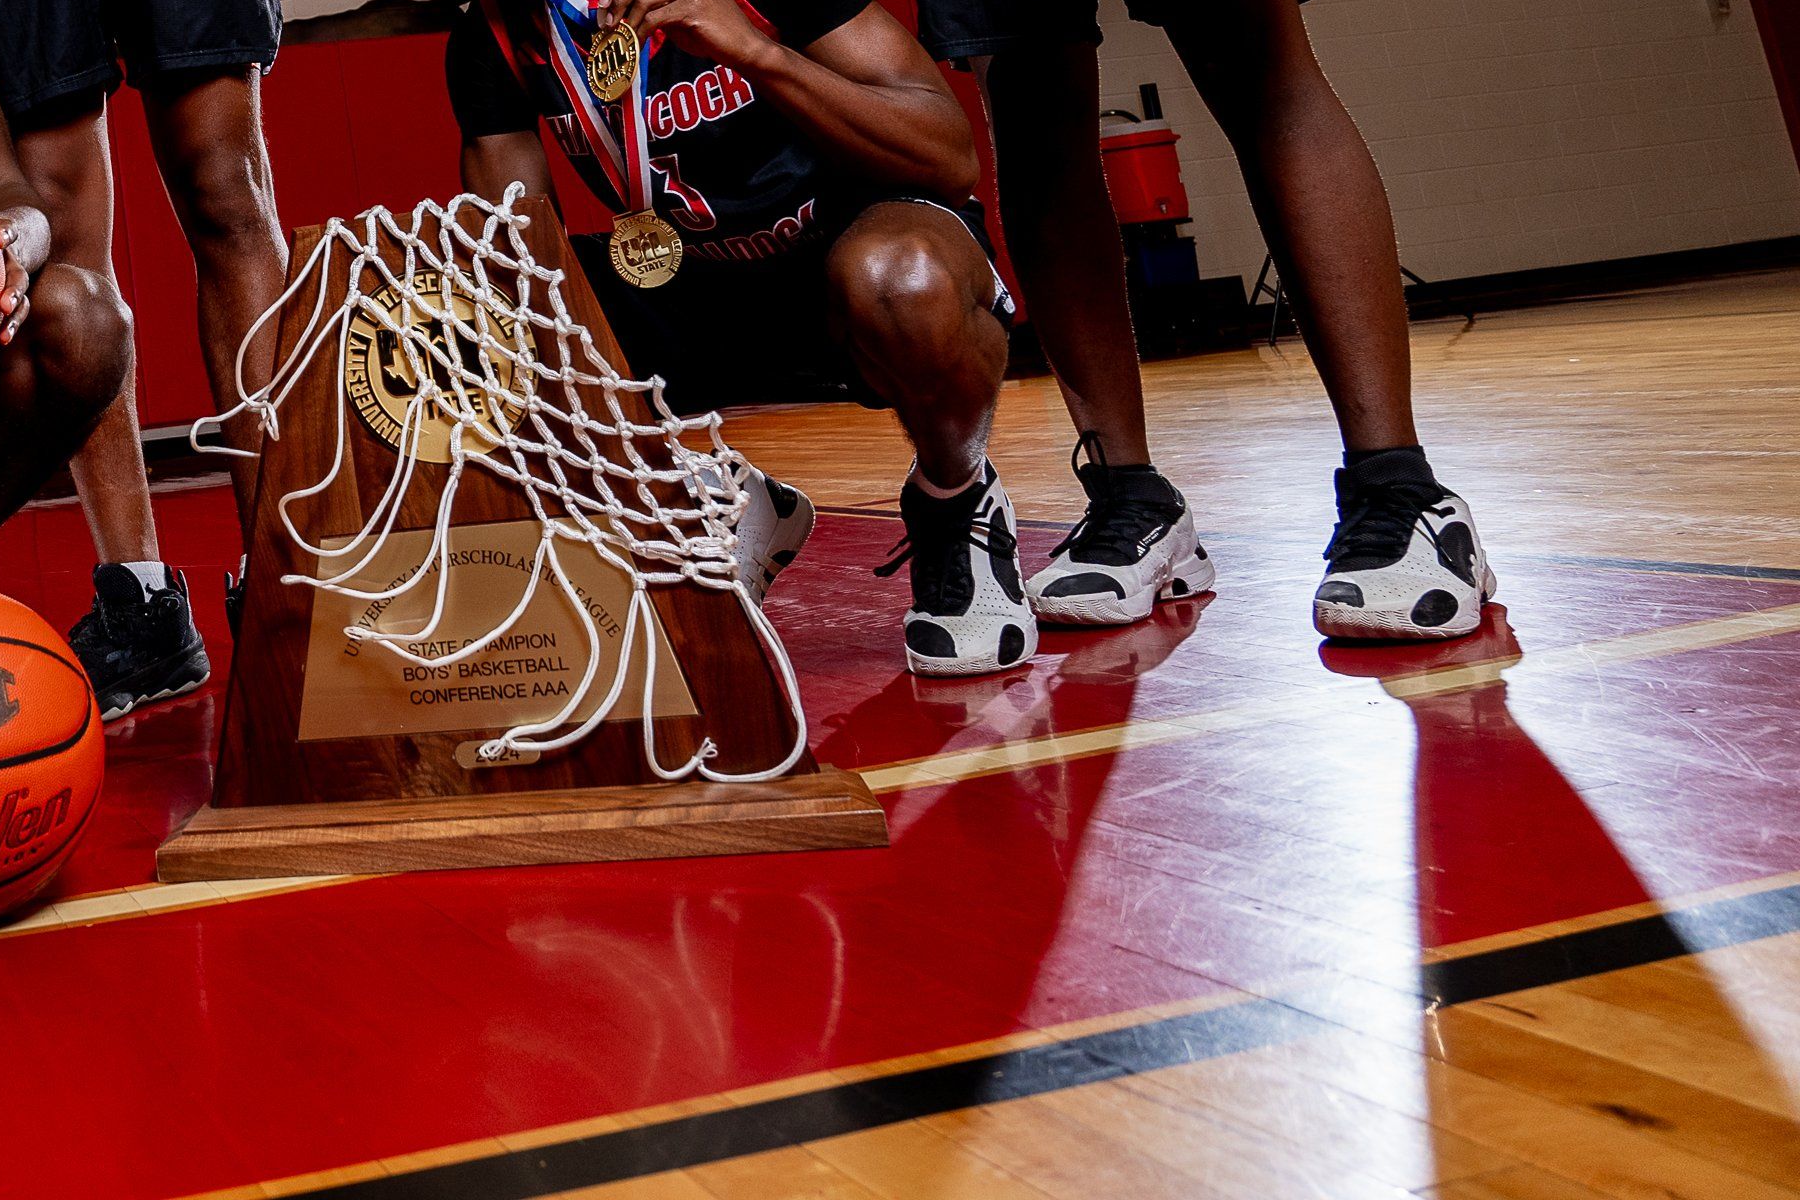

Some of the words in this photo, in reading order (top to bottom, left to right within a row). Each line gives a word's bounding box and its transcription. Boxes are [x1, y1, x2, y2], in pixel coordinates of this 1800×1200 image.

[648, 153, 717, 232] 3
[637, 260, 666, 275] STATE
[344, 570, 410, 658] UNVERSITY
[563, 580, 621, 638] EAGUE
[408, 640, 458, 657] STATE
[403, 665, 452, 682] BOYS'
[458, 656, 570, 679] BASKETBALL
[409, 682, 527, 706] CONFERENCE
[531, 681, 569, 697] AAA
